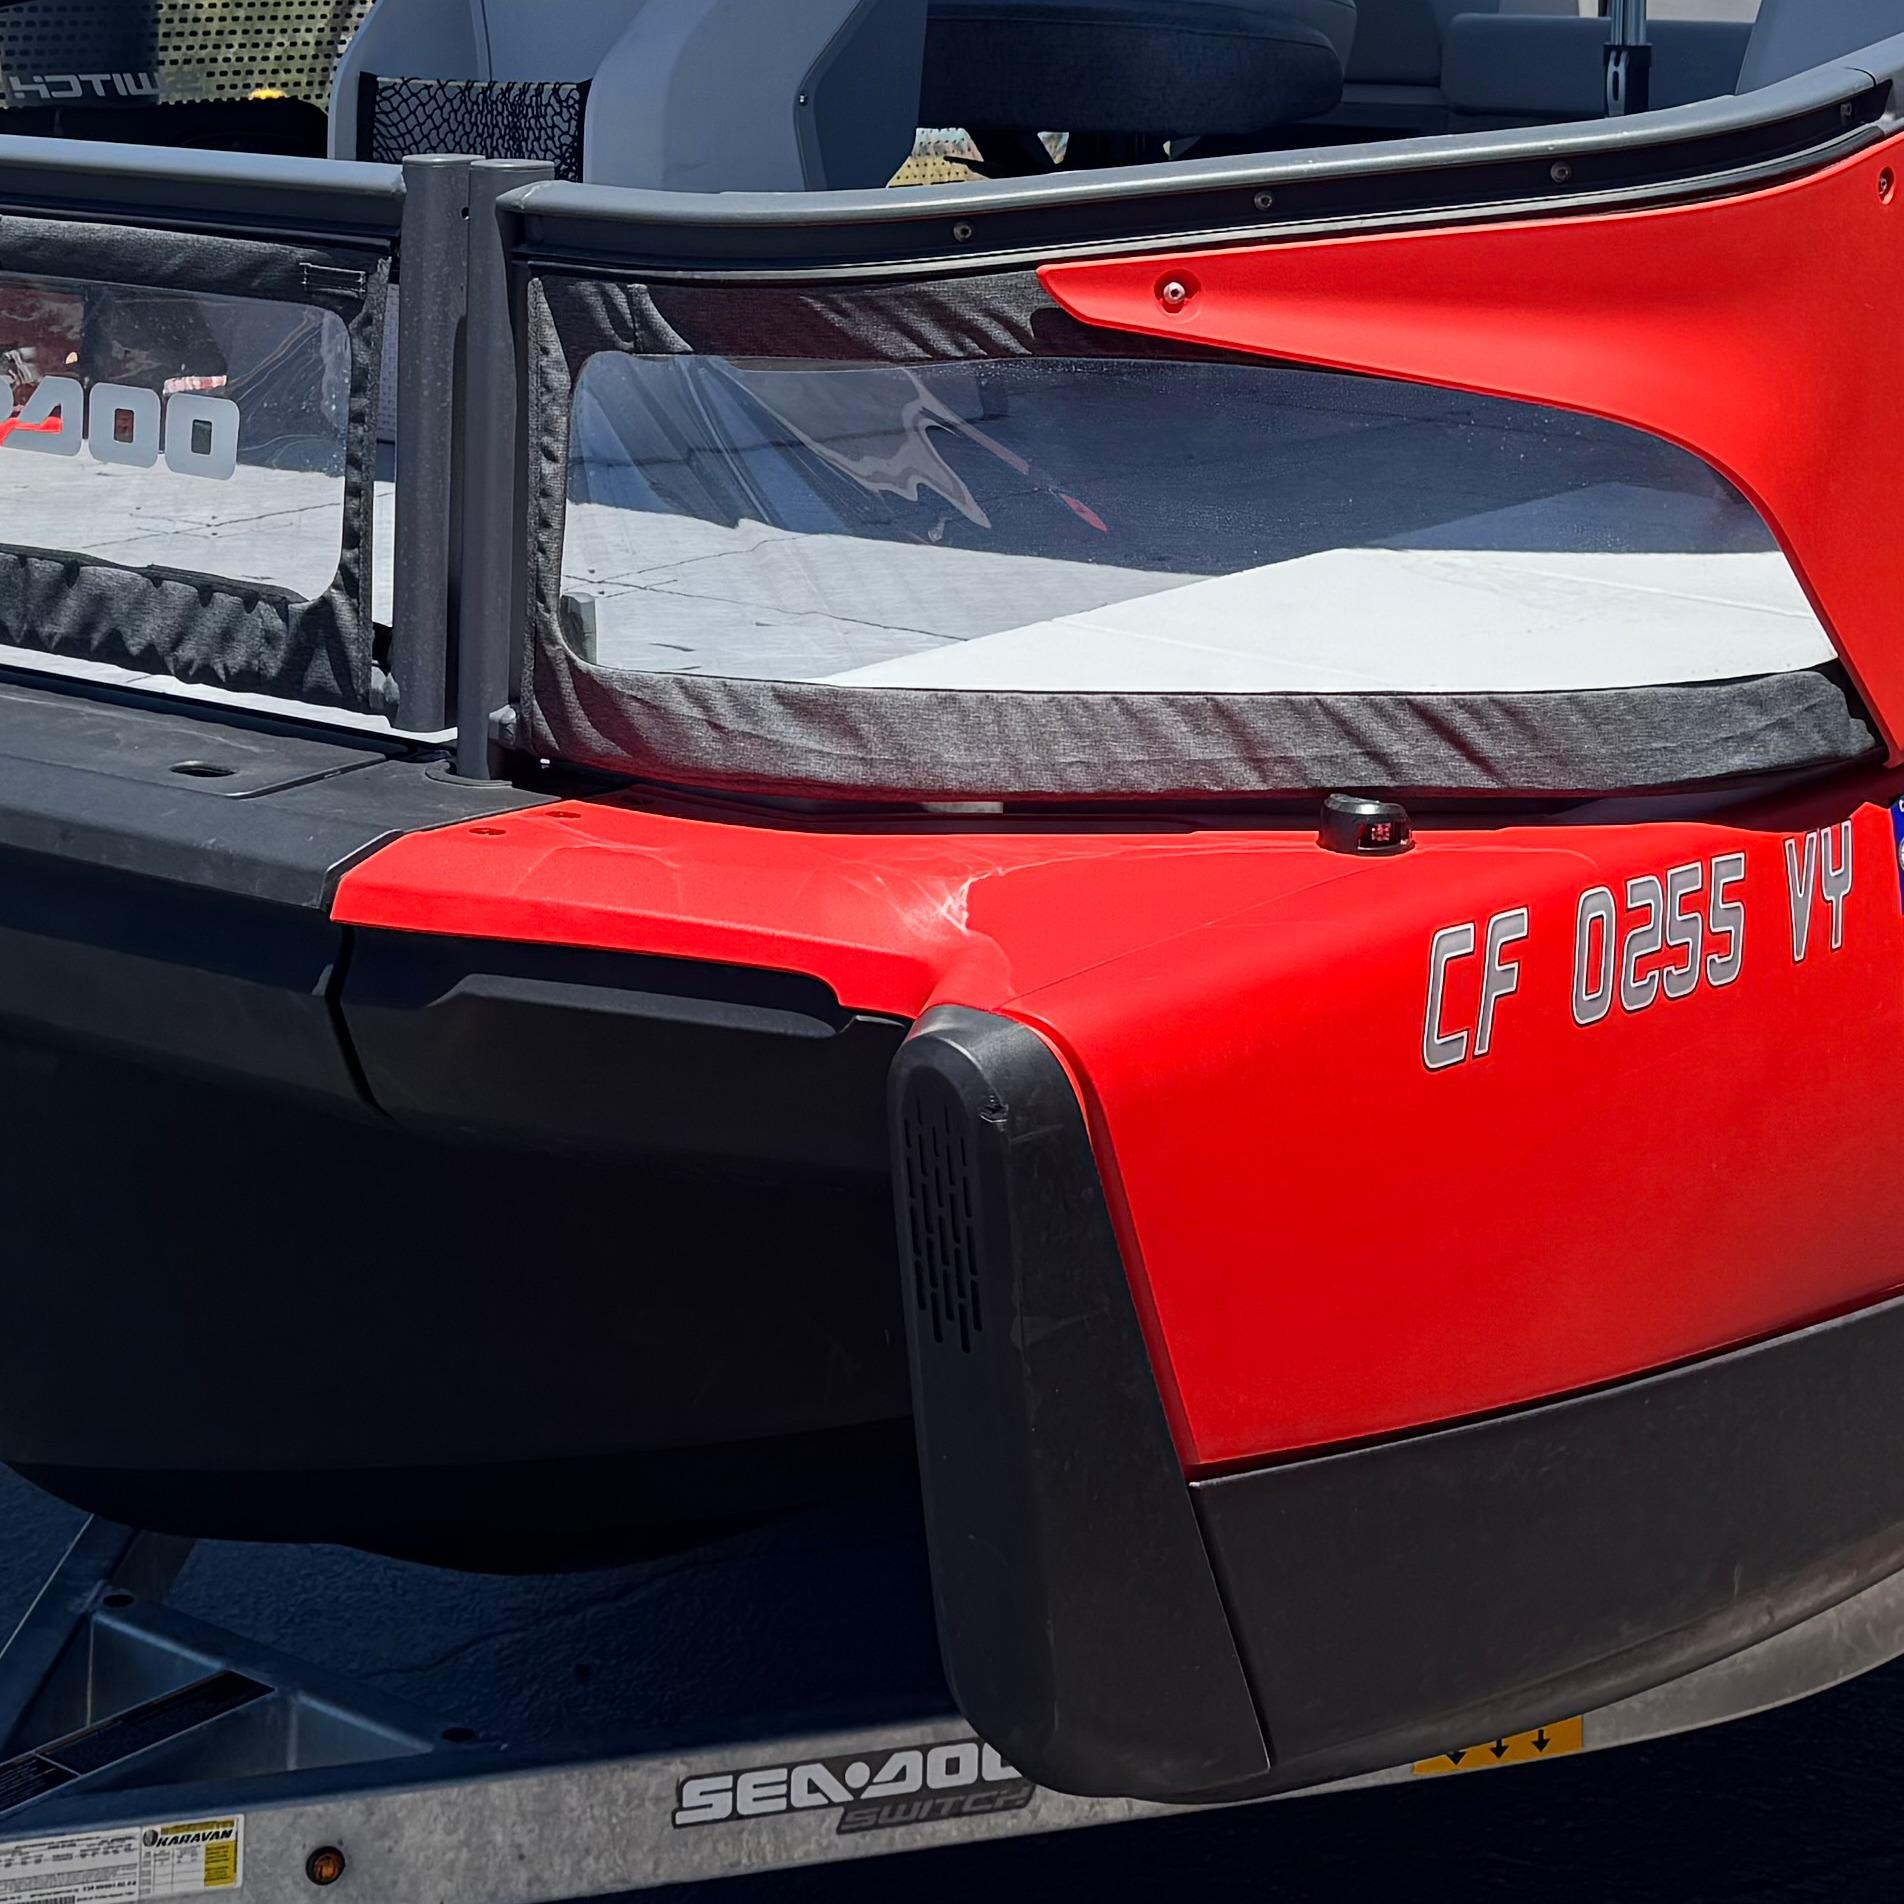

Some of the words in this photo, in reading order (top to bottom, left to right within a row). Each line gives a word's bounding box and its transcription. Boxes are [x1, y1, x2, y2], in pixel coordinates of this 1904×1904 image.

[1422, 906, 1529, 1070] CF
[1571, 852, 1747, 1026] 0255
[1784, 817, 1853, 964] VY
[155, 1828, 234, 1848] KARAVAN
